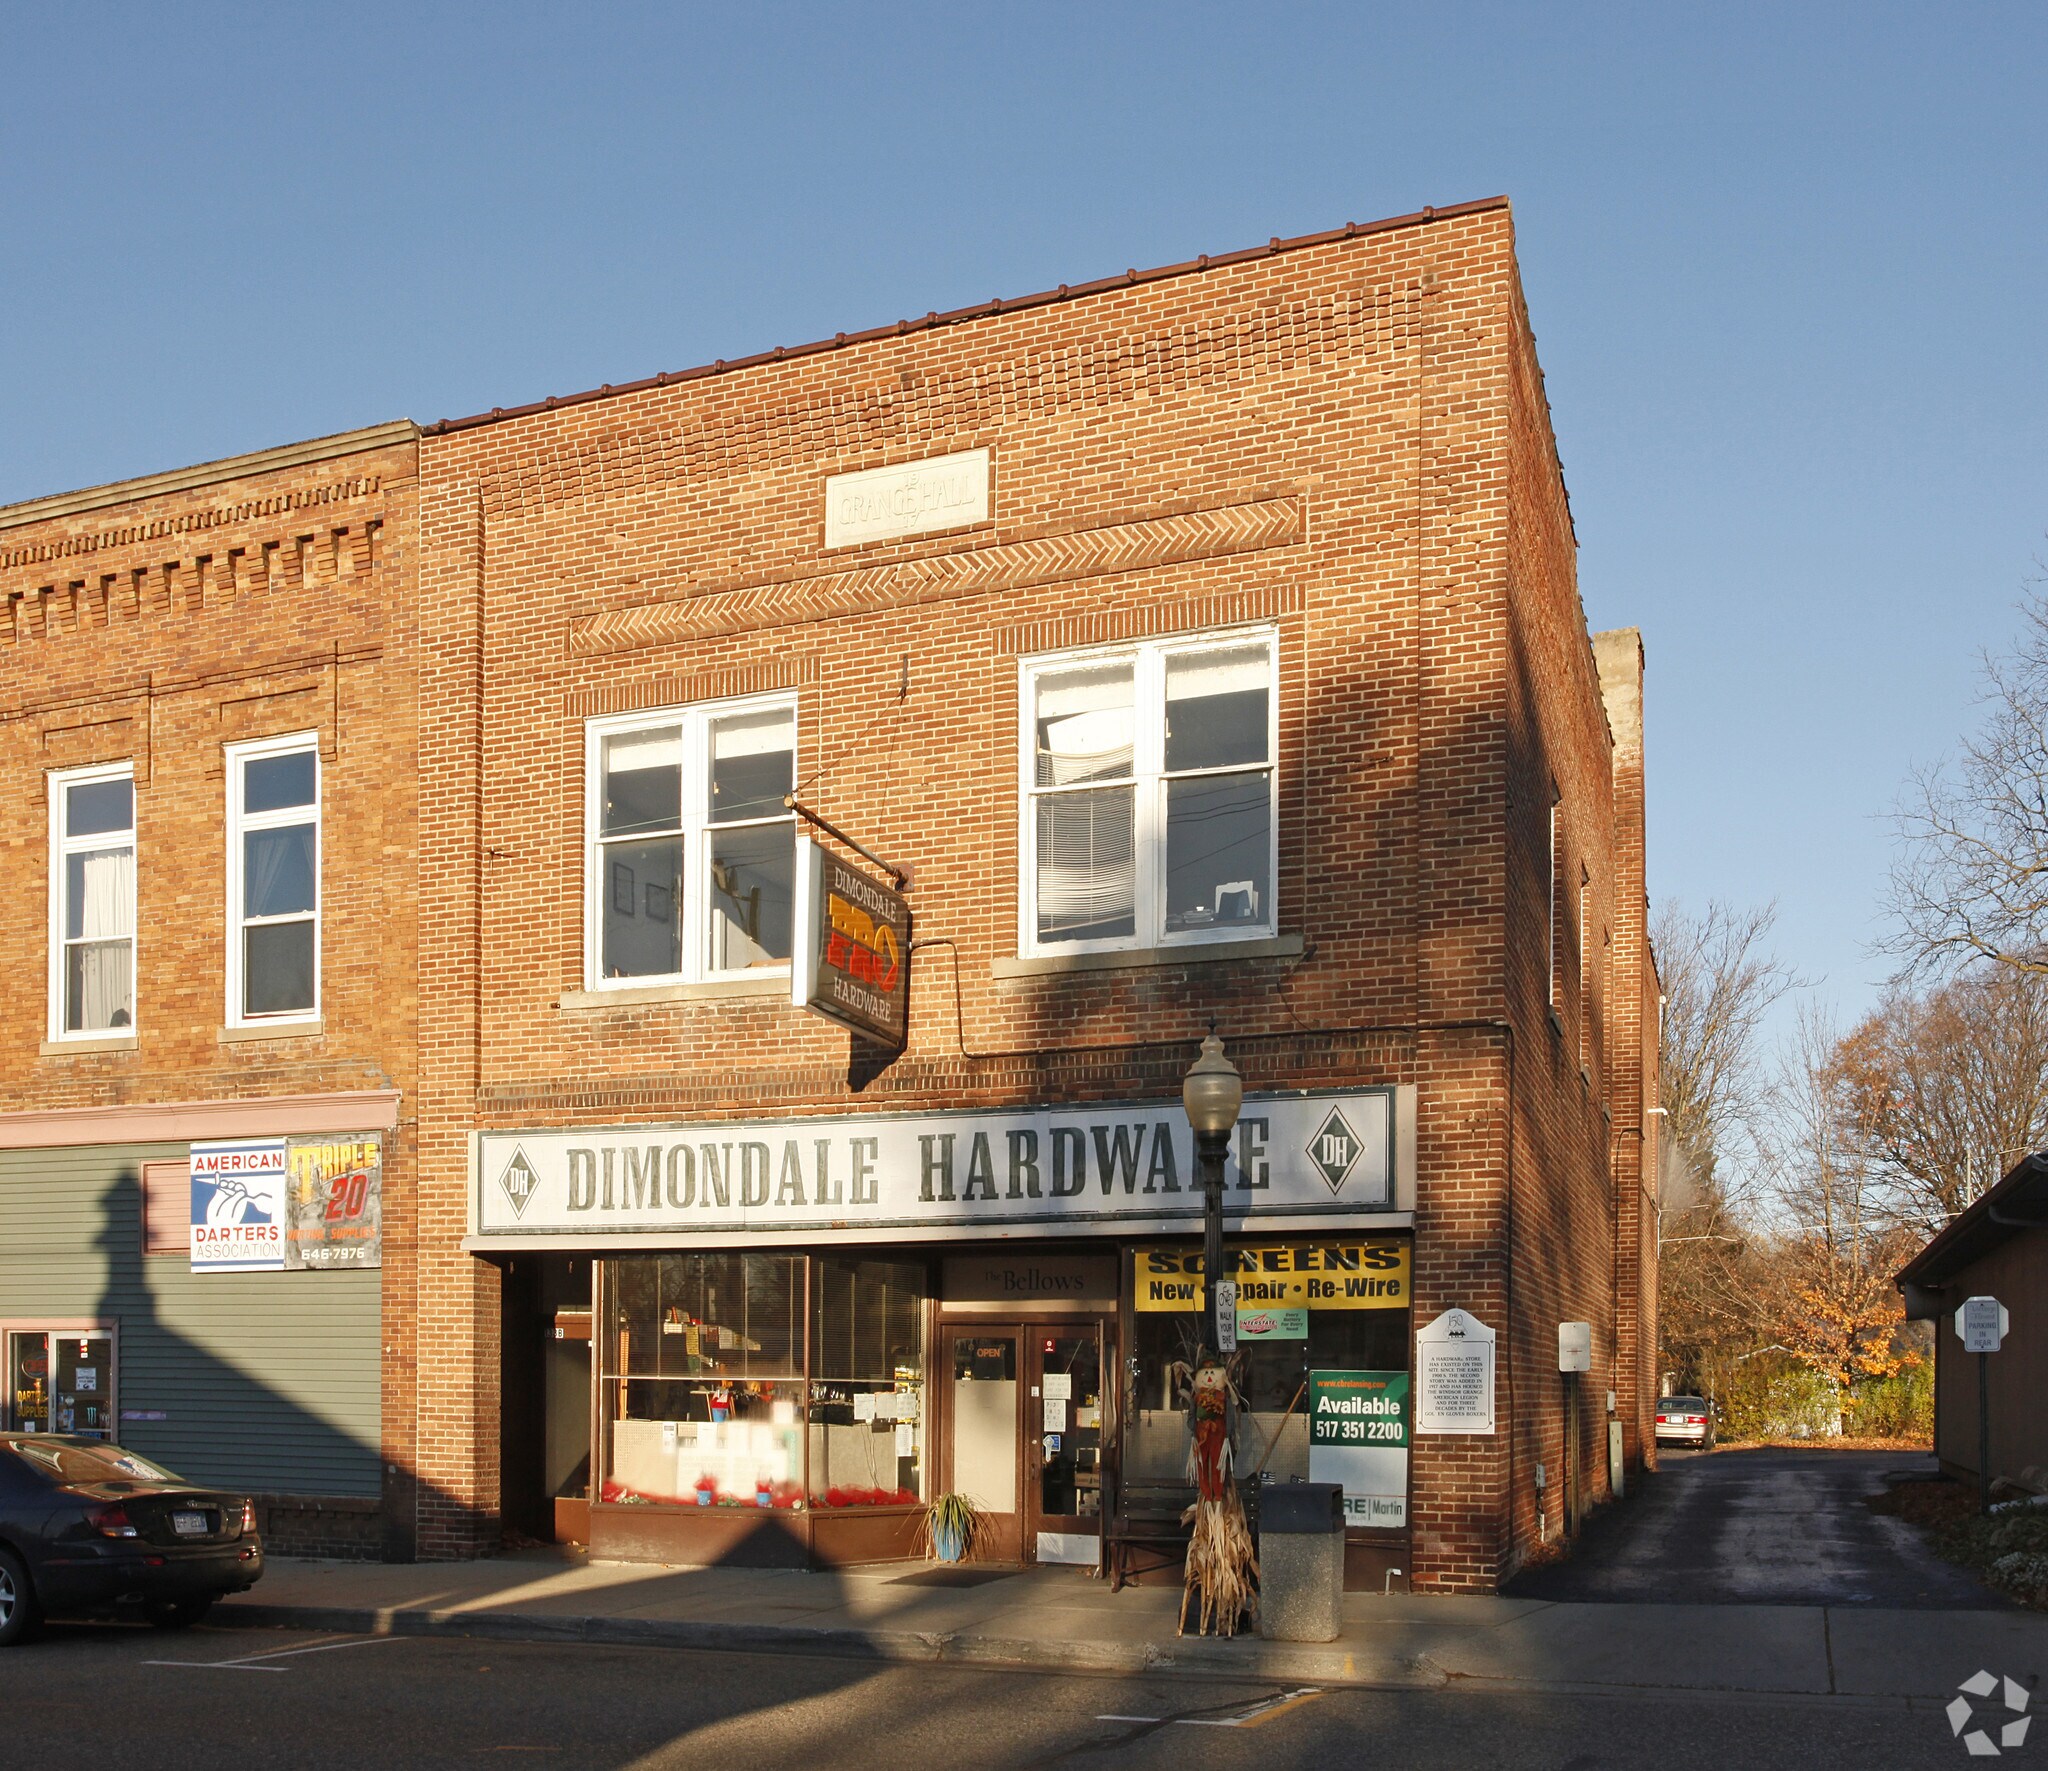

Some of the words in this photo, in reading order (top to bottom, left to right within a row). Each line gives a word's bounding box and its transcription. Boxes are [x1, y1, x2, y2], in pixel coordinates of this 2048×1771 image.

[904, 472, 920, 488] 19
[839, 487, 918, 525] GRANGE
[919, 475, 976, 513] HALL
[834, 866, 897, 923] DIMONDALE
[833, 976, 891, 1023] HARDWARE
[1321, 1132, 1350, 1169] DH
[194, 1152, 283, 1172] AMERICAN
[566, 1136, 880, 1212] DIMONDALE
[917, 1117, 1270, 1203] HARDWAE
[290, 1142, 378, 1208] TRIPLE
[509, 1166, 530, 1197] DH
[325, 1174, 369, 1222] 20
[196, 1225, 280, 1243] DARTERS
[330, 1227, 376, 1240] SUPPLIES
[196, 1243, 281, 1258] ASSOCIATION
[1148, 1246, 1401, 1275] SCREENS
[984, 1271, 1001, 1281] The
[1002, 1268, 1084, 1291] Bellows
[1149, 1280, 1195, 1301] New
[1235, 1280, 1287, 1302] epair
[1307, 1277, 1400, 1299] Re-Wire
[1220, 1311, 1232, 1320] WALK
[1448, 1314, 1464, 1328] 150
[1220, 1323, 1232, 1333] YOUR
[1222, 1335, 1232, 1344] BIKE
[976, 1348, 1001, 1358] OPEN
[1317, 1379, 1386, 1390] www.cbrelansing.com
[17, 1406, 48, 1418] SUPPLIES
[1317, 1396, 1401, 1415] Available
[1316, 1421, 1338, 1438] 517
[1341, 1421, 1365, 1439] 351
[1367, 1422, 1403, 1440] 2200
[1343, 1498, 1366, 1514] RE
[1372, 1499, 1402, 1516] Martin
